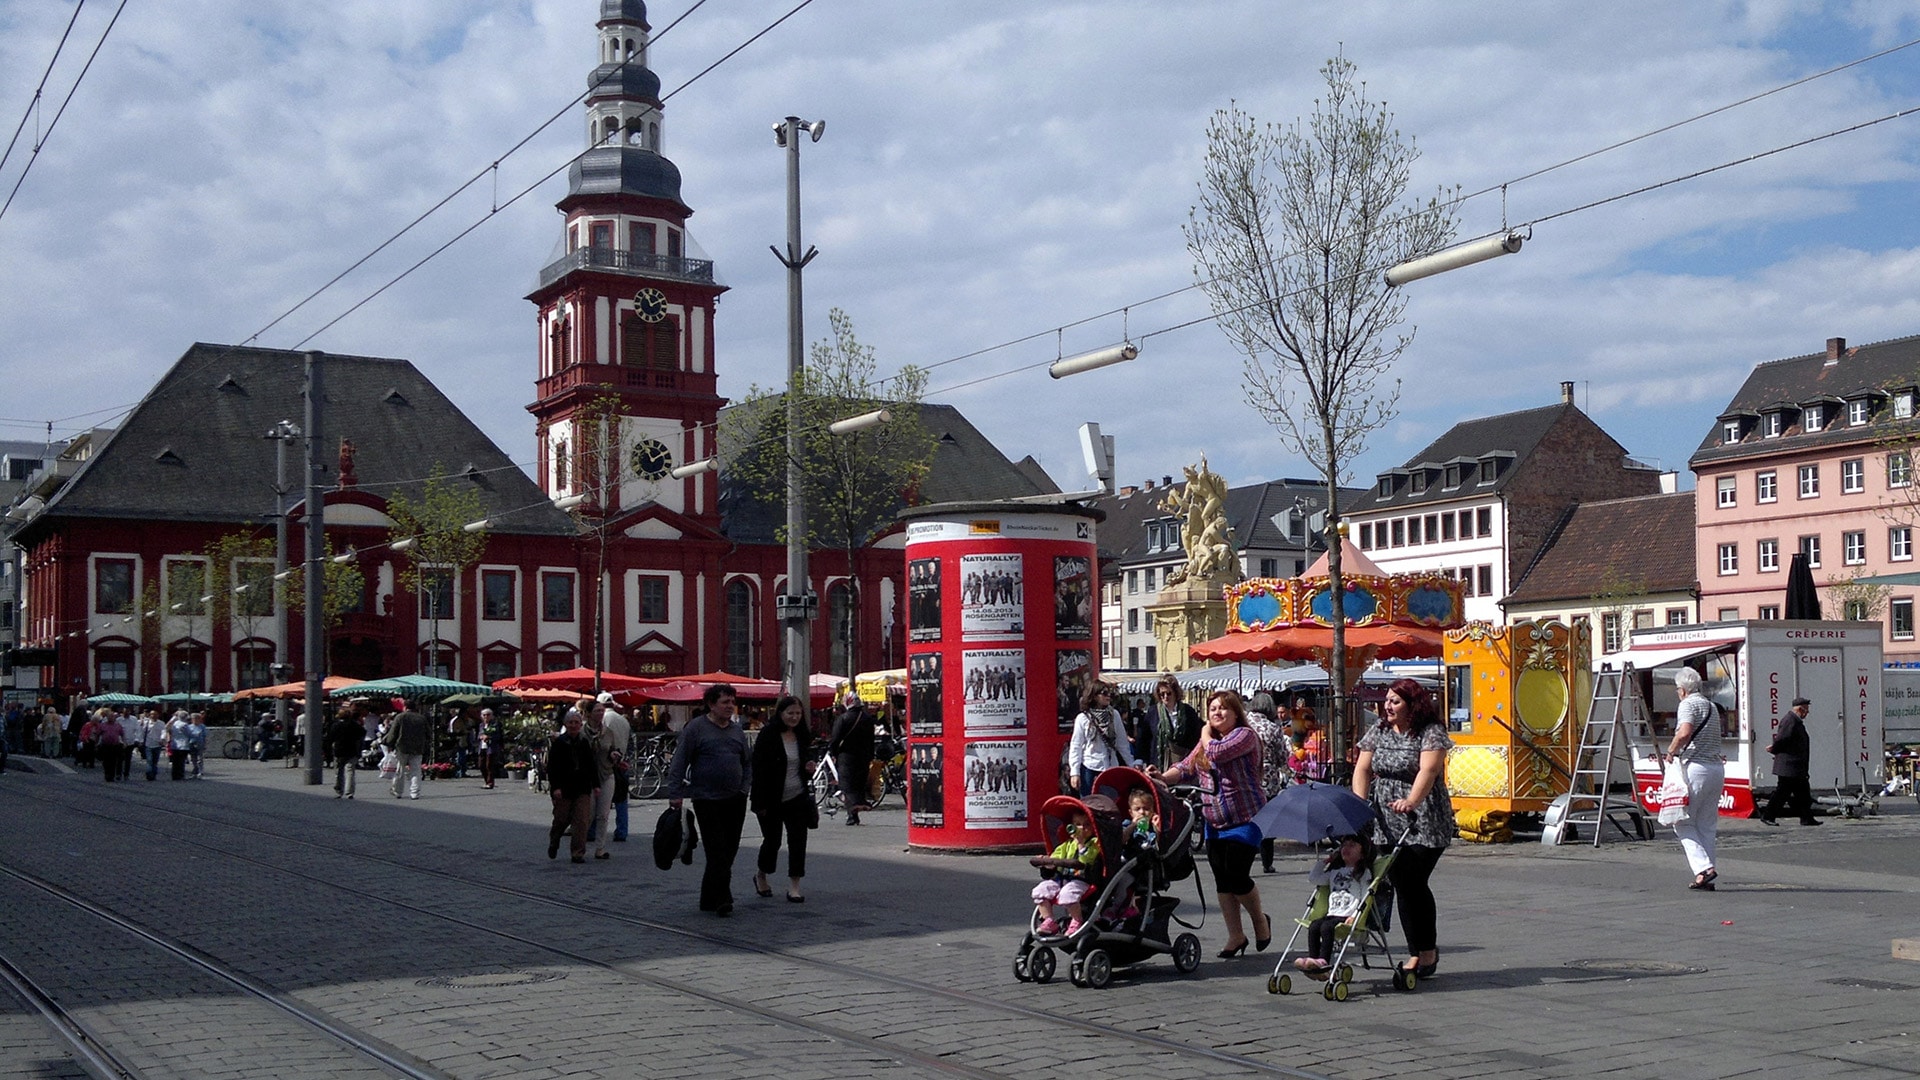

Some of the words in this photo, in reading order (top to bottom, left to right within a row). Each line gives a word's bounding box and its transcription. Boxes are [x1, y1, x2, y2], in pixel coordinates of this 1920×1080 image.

[1688, 632, 1707, 640] CHRIS
[1786, 629, 1847, 638] CRÊPERIE
[1801, 655, 1838, 663] CHRIS
[1739, 659, 1747, 731] WAFFELN
[1857, 675, 1869, 762] WAFFELN
